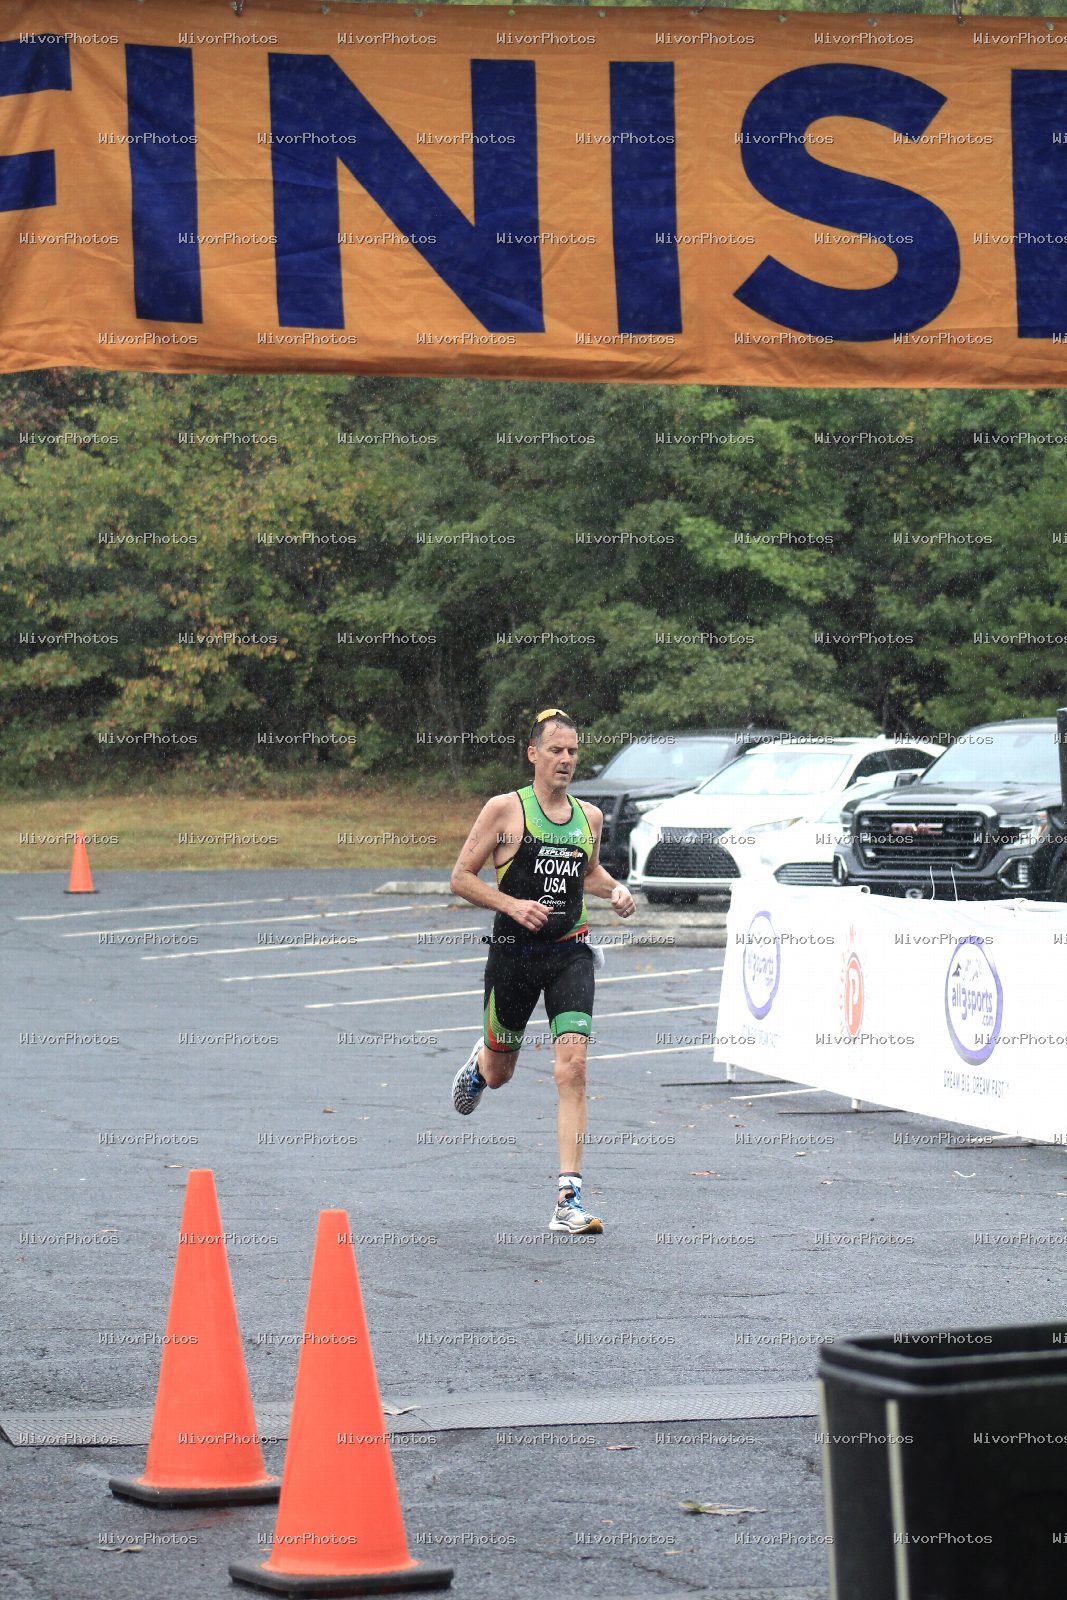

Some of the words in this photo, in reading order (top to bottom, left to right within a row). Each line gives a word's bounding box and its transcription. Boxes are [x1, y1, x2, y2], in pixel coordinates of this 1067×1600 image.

[0, 36, 1067, 341] INIS
[891, 822, 944, 835] GMC
[534, 859, 581, 877] KOVAK
[544, 877, 567, 893] USA
[951, 983, 993, 1020] all3sports
